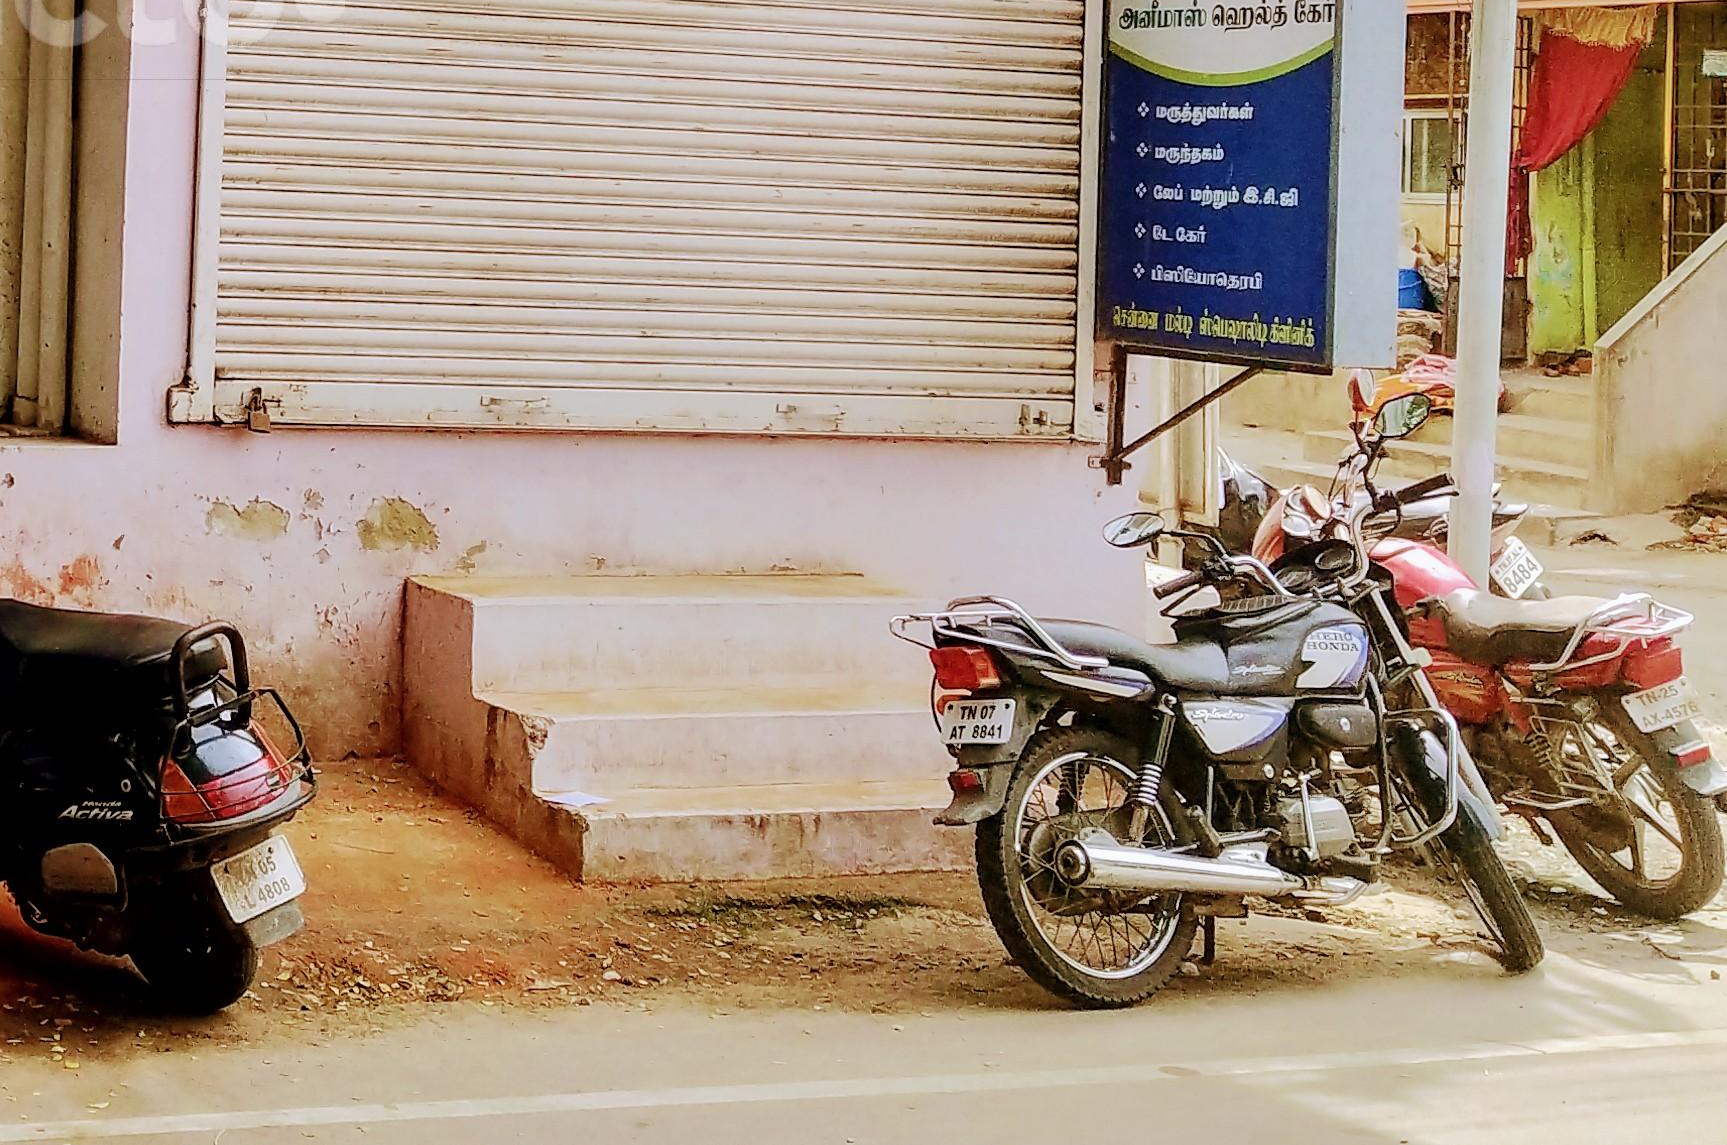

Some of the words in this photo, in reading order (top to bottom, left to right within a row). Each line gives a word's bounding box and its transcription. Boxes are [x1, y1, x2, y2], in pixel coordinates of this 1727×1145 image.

[1155, 102, 1254, 126] மருத்துவர்கள்
[1154, 143, 1224, 164] மருந்தகம்
[1153, 183, 1183, 200] லேப்
[1190, 185, 1239, 209] மற்றும்
[1176, 225, 1207, 244] கேர்
[1503, 556, 1538, 593] 8484
[1306, 641, 1360, 652] HONDA
[960, 705, 977, 720] TN
[981, 705, 996, 720] 07
[949, 725, 966, 740] AT
[972, 724, 1002, 739] 8841
[57, 805, 133, 821] Activa
[258, 856, 277, 875] 05
[258, 876, 290, 904] 4808
